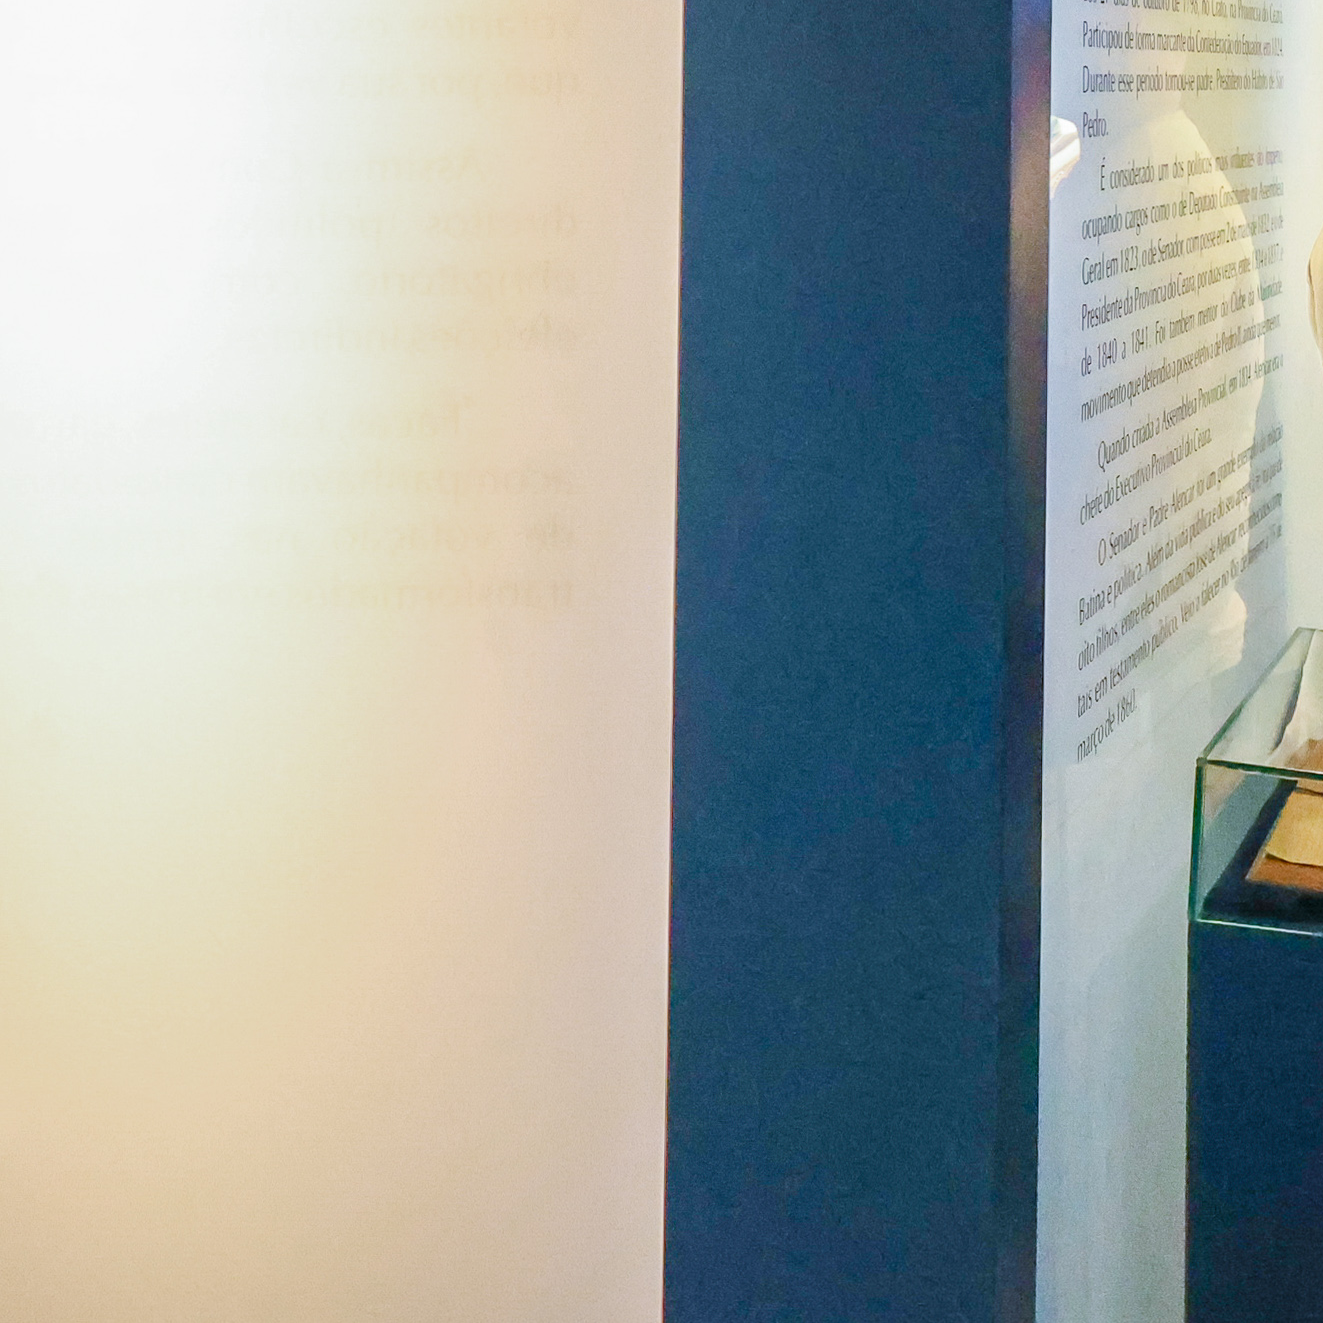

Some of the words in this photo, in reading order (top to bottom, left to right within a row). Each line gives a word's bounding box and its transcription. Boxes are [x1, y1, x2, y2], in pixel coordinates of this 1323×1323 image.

[1083, 20, 1123, 55] Participou
[1124, 22, 1134, 50] de
[1082, 65, 1116, 93] Durante
[1118, 74, 1134, 93] esse
[1082, 110, 1108, 139] Pedro.
[1110, 160, 1155, 189] considerado
[1158, 163, 1169, 182] um
[1082, 206, 1123, 244] ocupando
[1082, 253, 1105, 285] Geral
[1106, 257, 1119, 279] em
[1081, 296, 1122, 330] Presidente
[1123, 289, 1133, 316] da
[1081, 347, 1092, 377] de
[1098, 338, 1118, 369] 1840
[1081, 384, 1126, 422] movimento
[1127, 377, 1141, 406] que
[1098, 428, 1130, 472] Quando
